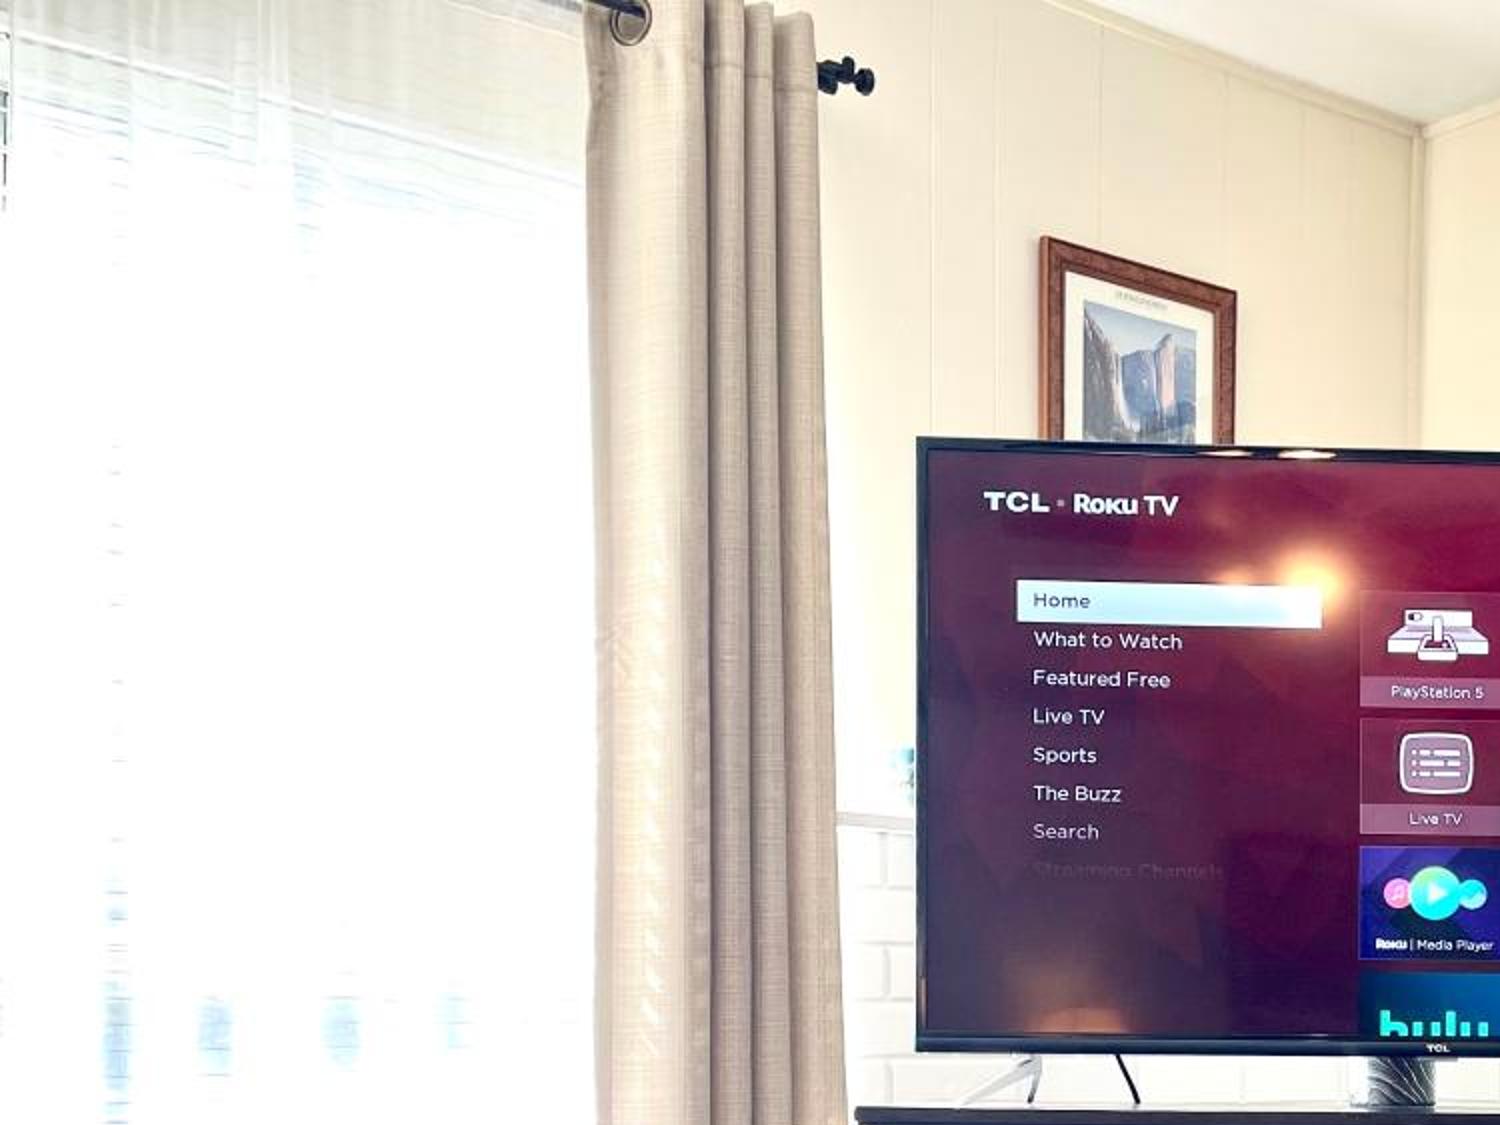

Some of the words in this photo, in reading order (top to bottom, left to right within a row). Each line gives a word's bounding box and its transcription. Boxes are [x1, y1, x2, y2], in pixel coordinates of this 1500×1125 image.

[983, 491, 1050, 512] TCL
[1143, 496, 1179, 517] TV
[1033, 592, 1091, 609] Home
[1034, 632, 1086, 648] What
[1092, 634, 1113, 648] to
[1119, 634, 1183, 650] Watch
[1033, 670, 1121, 687] Featured
[1126, 672, 1171, 688] Free
[1391, 684, 1471, 699] PlayStation
[1475, 686, 1484, 699] 5
[1033, 708, 1073, 725] Live
[1079, 709, 1105, 725] TV
[1033, 747, 1097, 764] Sports
[1034, 786, 1067, 802] The
[1075, 786, 1121, 803] Buzz
[1410, 812, 1438, 825] Live
[1442, 812, 1463, 825] TV
[1033, 824, 1099, 840] Search
[1417, 940, 1453, 951] Media
[1456, 940, 1494, 952] Player
[1380, 1010, 1489, 1037] hulu
[1426, 1043, 1451, 1052] TCL
